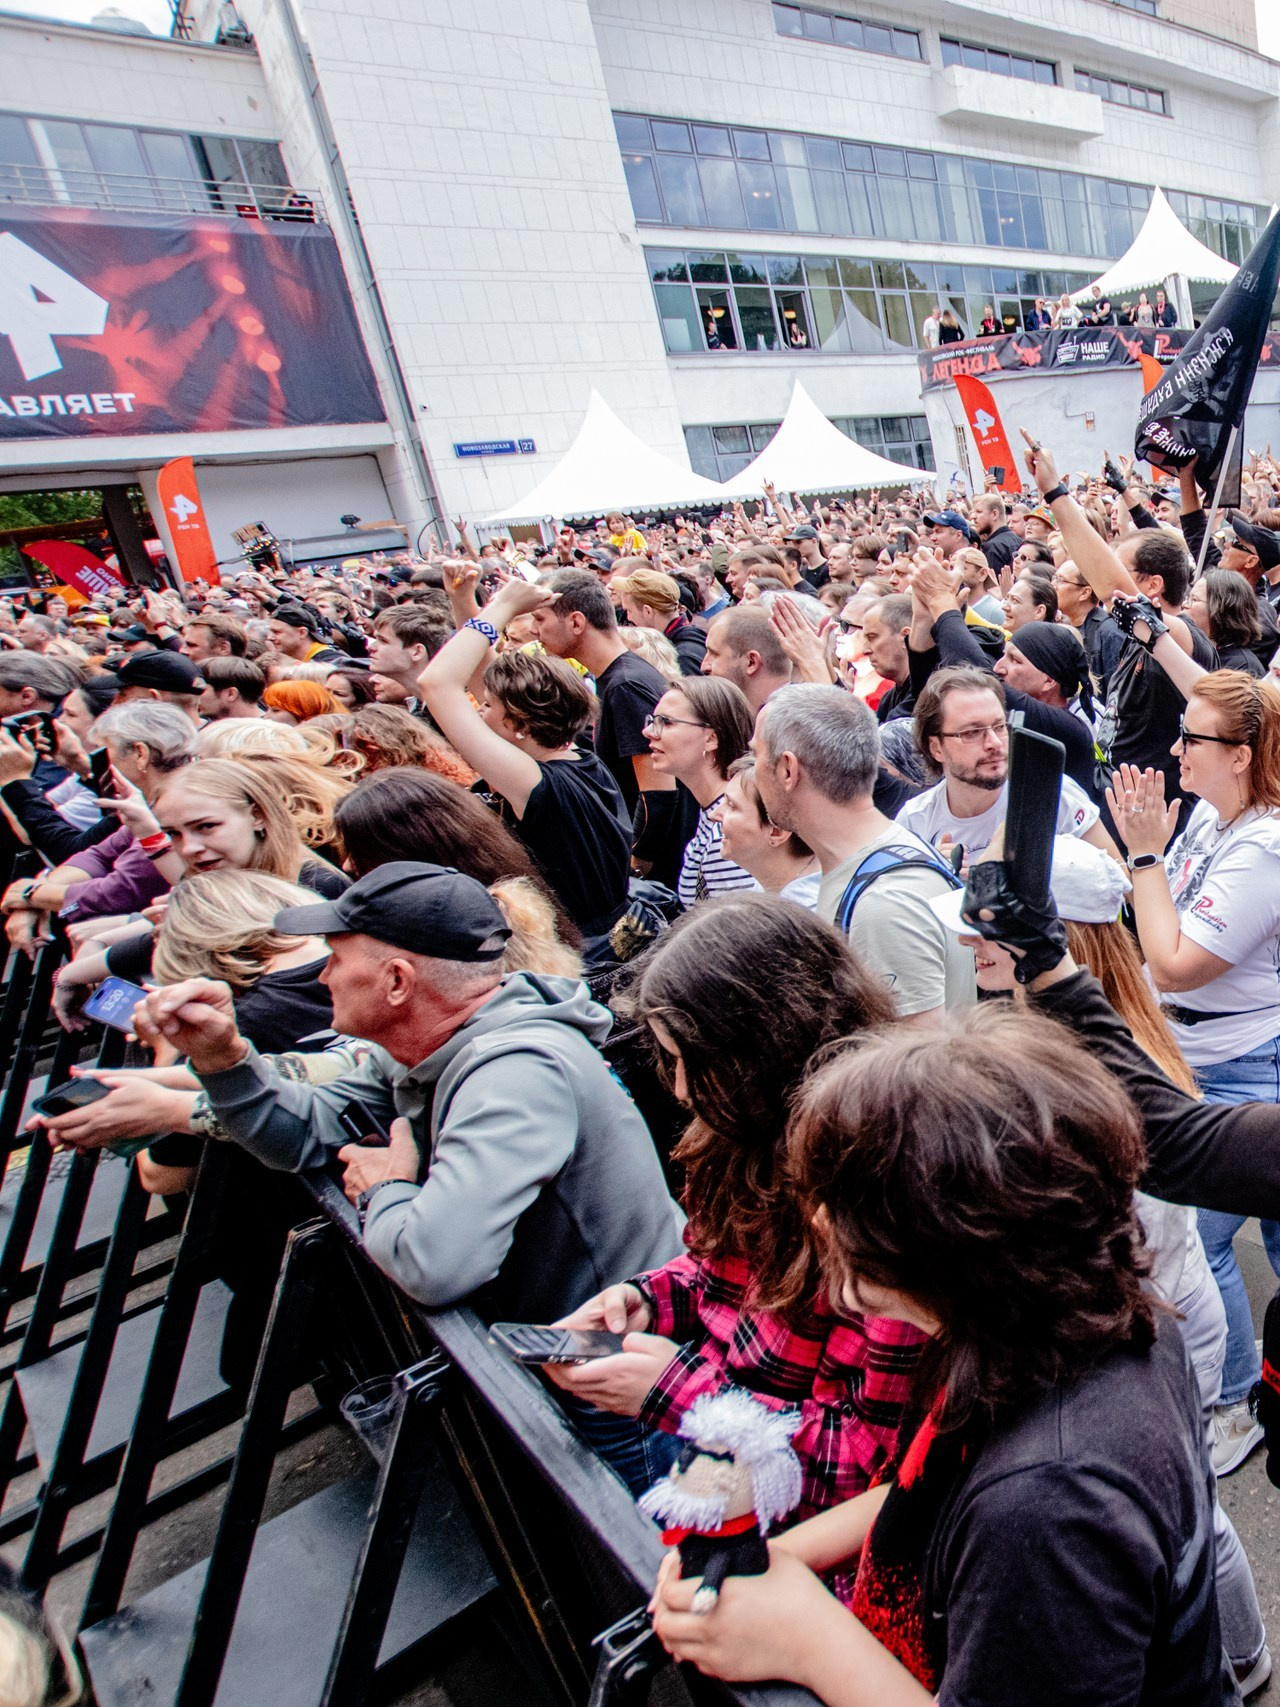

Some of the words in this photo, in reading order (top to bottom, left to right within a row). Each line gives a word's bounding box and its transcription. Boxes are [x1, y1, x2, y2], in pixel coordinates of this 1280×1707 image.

[1081, 342, 1109, 353] НАШЕ
[932, 352, 1002, 381] ЛЕГЕНДА
[461, 442, 511, 452] НОВОЗАВОДСКАЯ
[522, 441, 533, 451] 27
[75, 565, 109, 596] АШЕ
[100, 988, 125, 1012] 13:20
